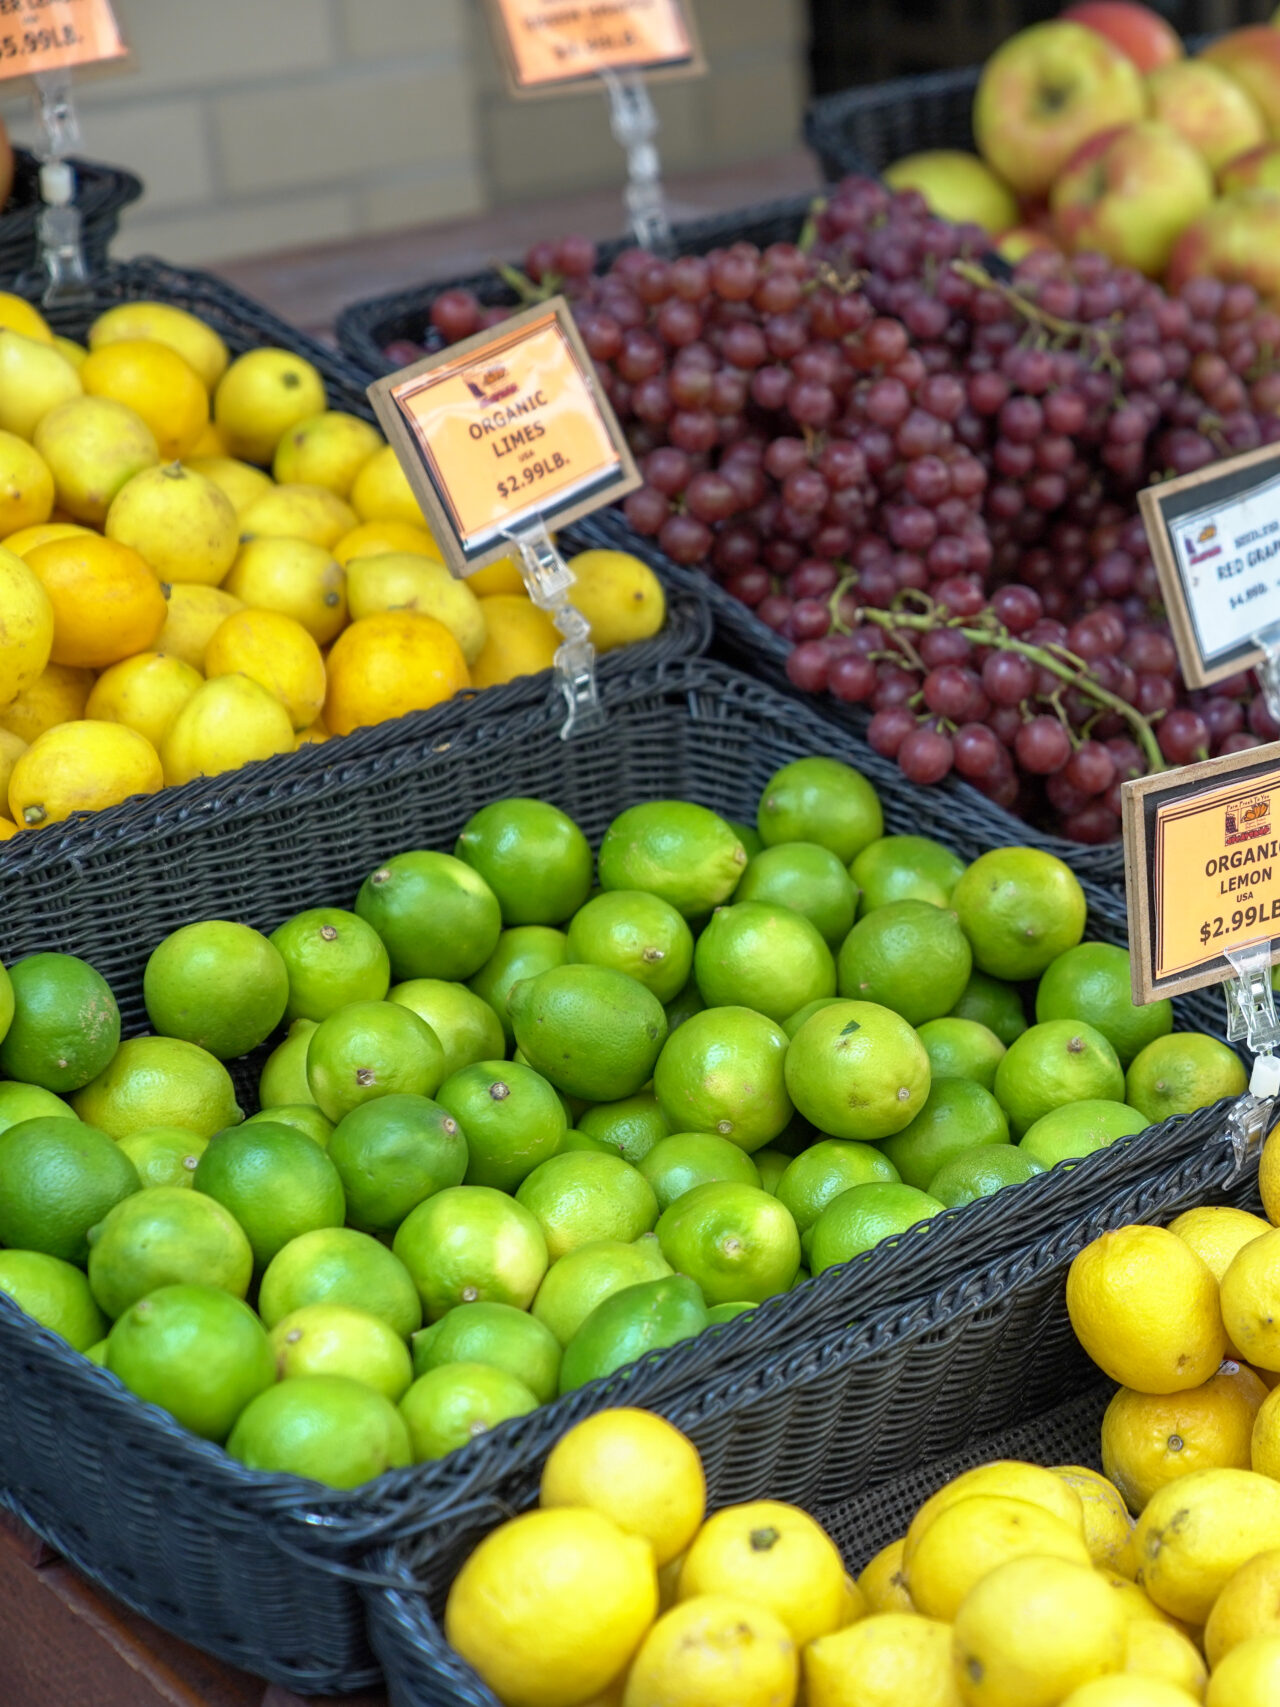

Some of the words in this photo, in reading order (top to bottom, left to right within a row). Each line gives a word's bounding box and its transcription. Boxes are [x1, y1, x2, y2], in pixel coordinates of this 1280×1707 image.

[0, 25, 84, 58] 5.99LB.
[469, 391, 548, 440] ORGANIC
[492, 420, 546, 458] LIMES
[497, 452, 570, 499] $2.99LB.
[1217, 557, 1244, 580] RED
[1220, 866, 1273, 895] LEMON
[1236, 891, 1254, 903] USA
